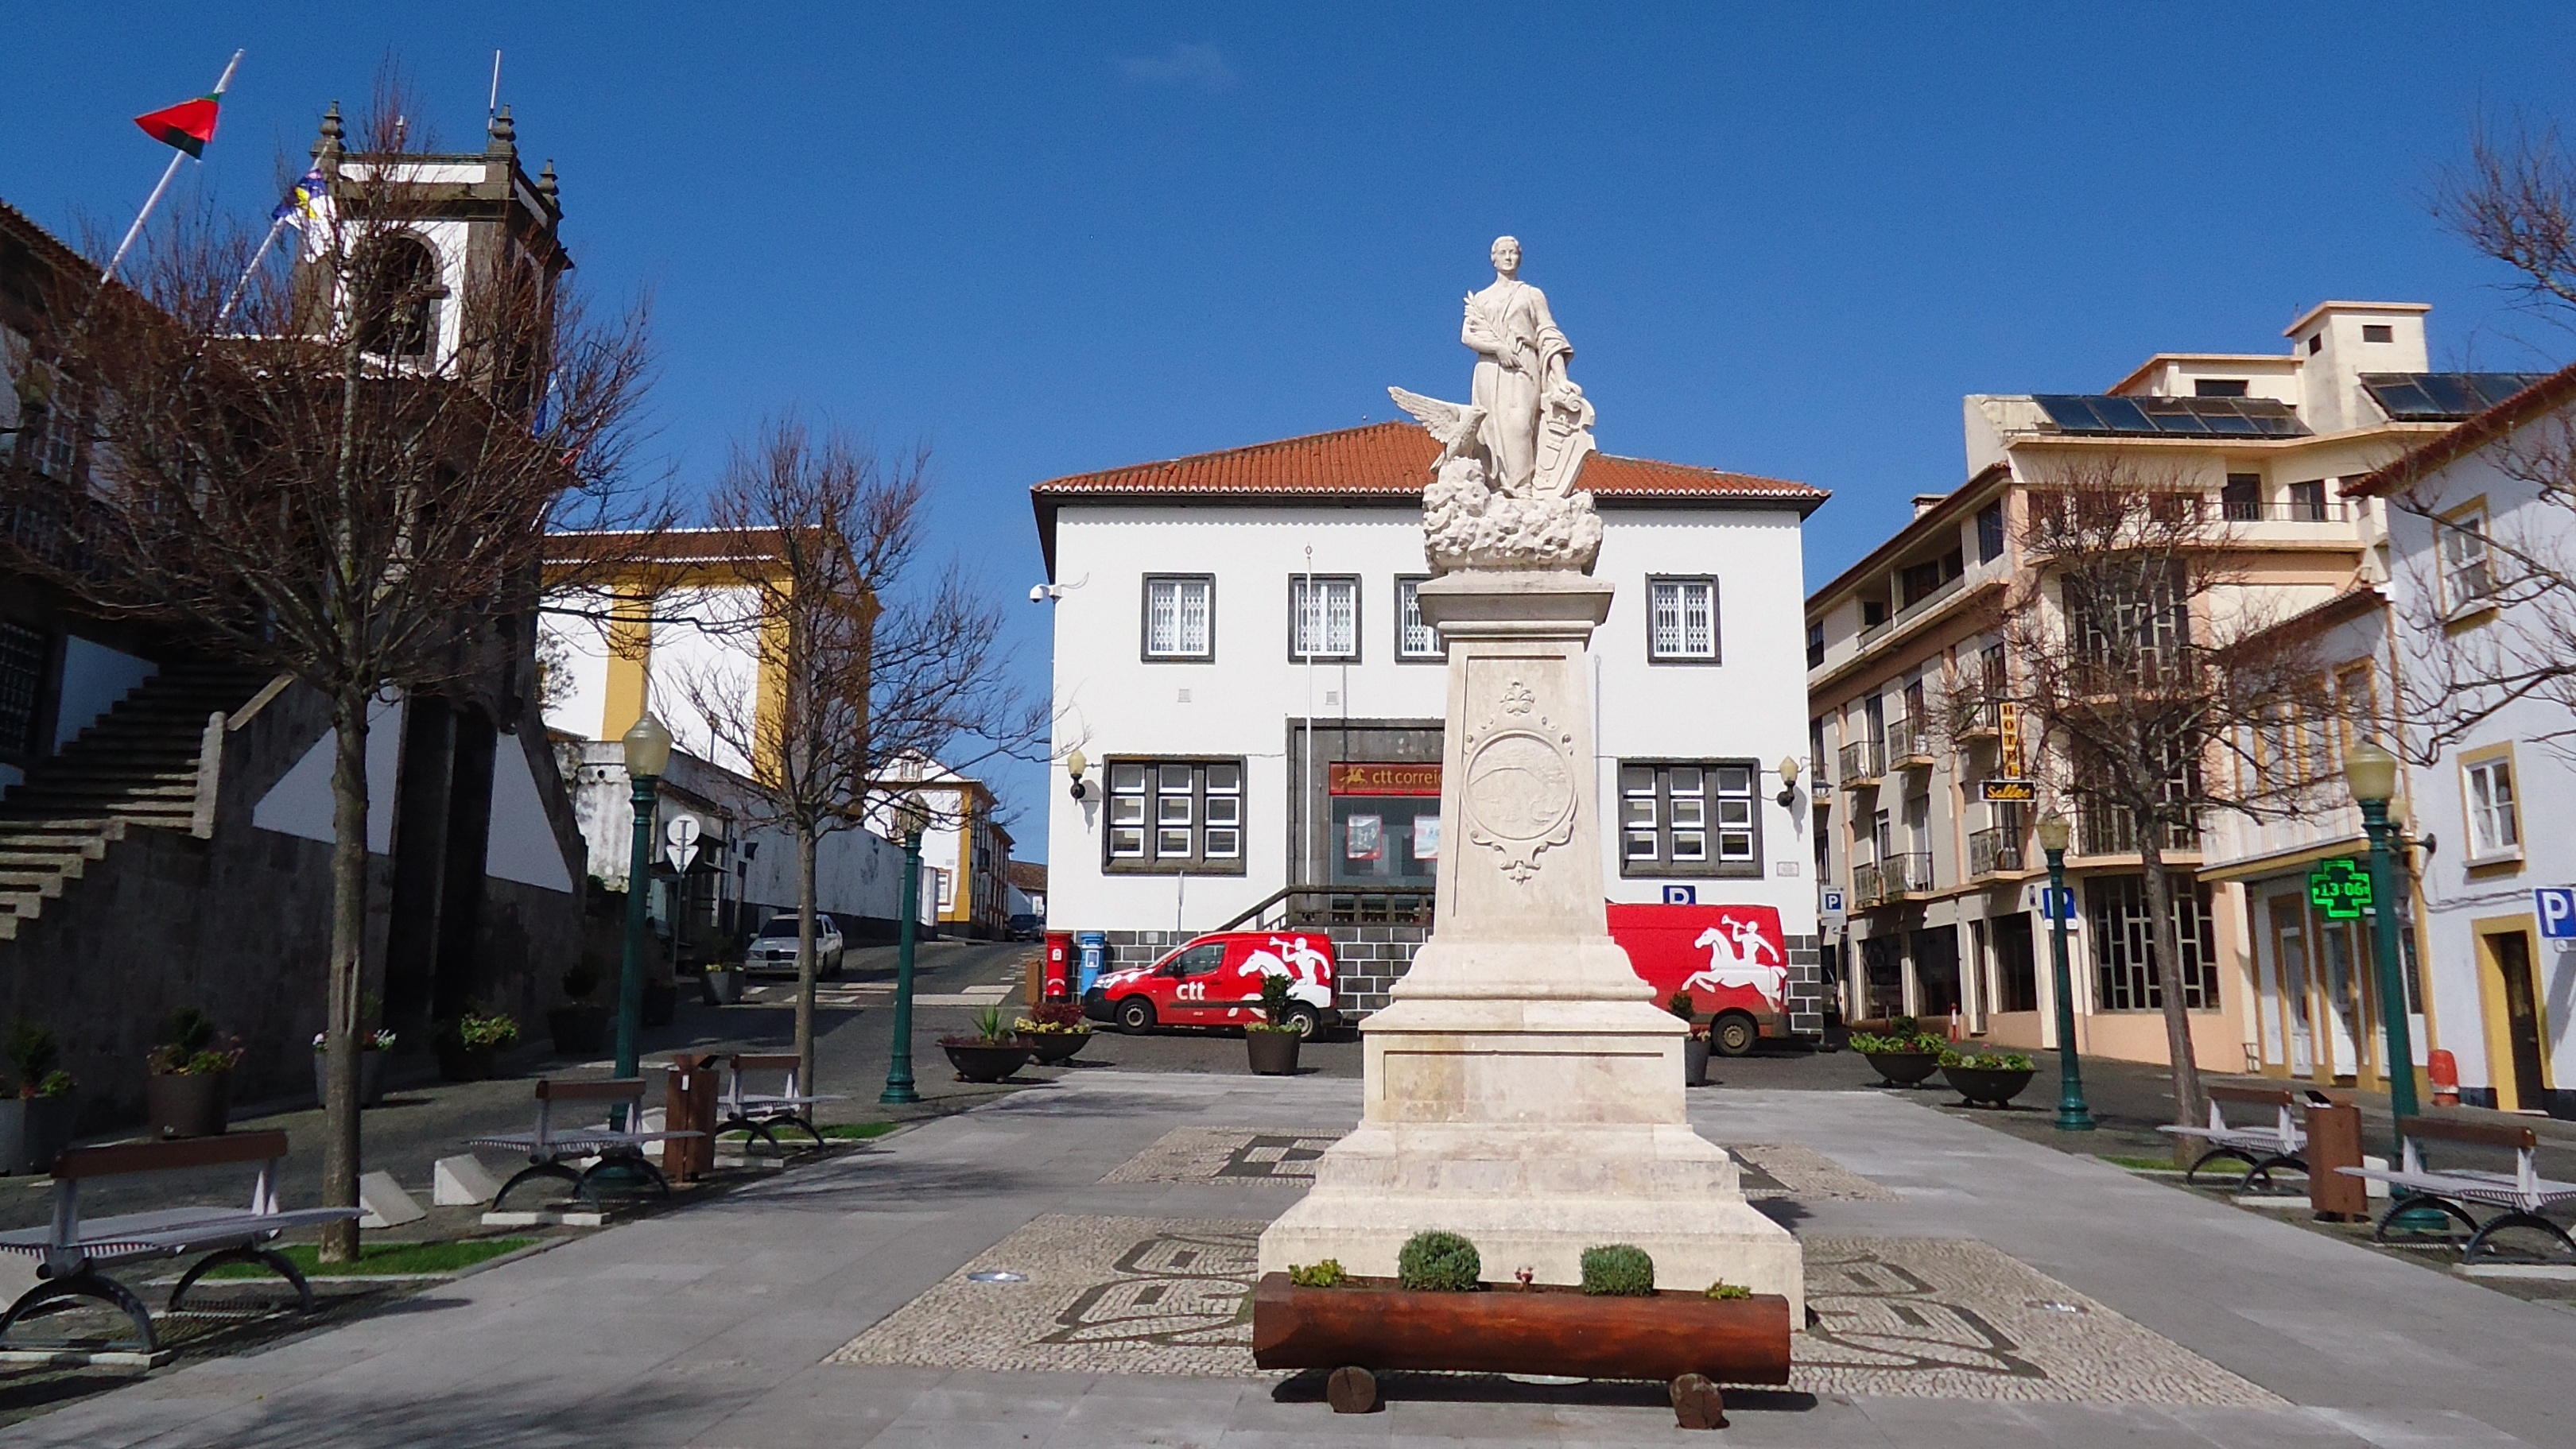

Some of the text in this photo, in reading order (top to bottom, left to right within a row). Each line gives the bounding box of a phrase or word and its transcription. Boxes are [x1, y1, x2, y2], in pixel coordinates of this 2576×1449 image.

[2003, 704, 2019, 777] HOTEL
[1372, 770, 1392, 784] ctt
[2321, 881, 2364, 896] 13:06
[1828, 895, 1839, 909] P
[2541, 891, 2568, 935] P
[1176, 981, 1205, 1001] ctt
